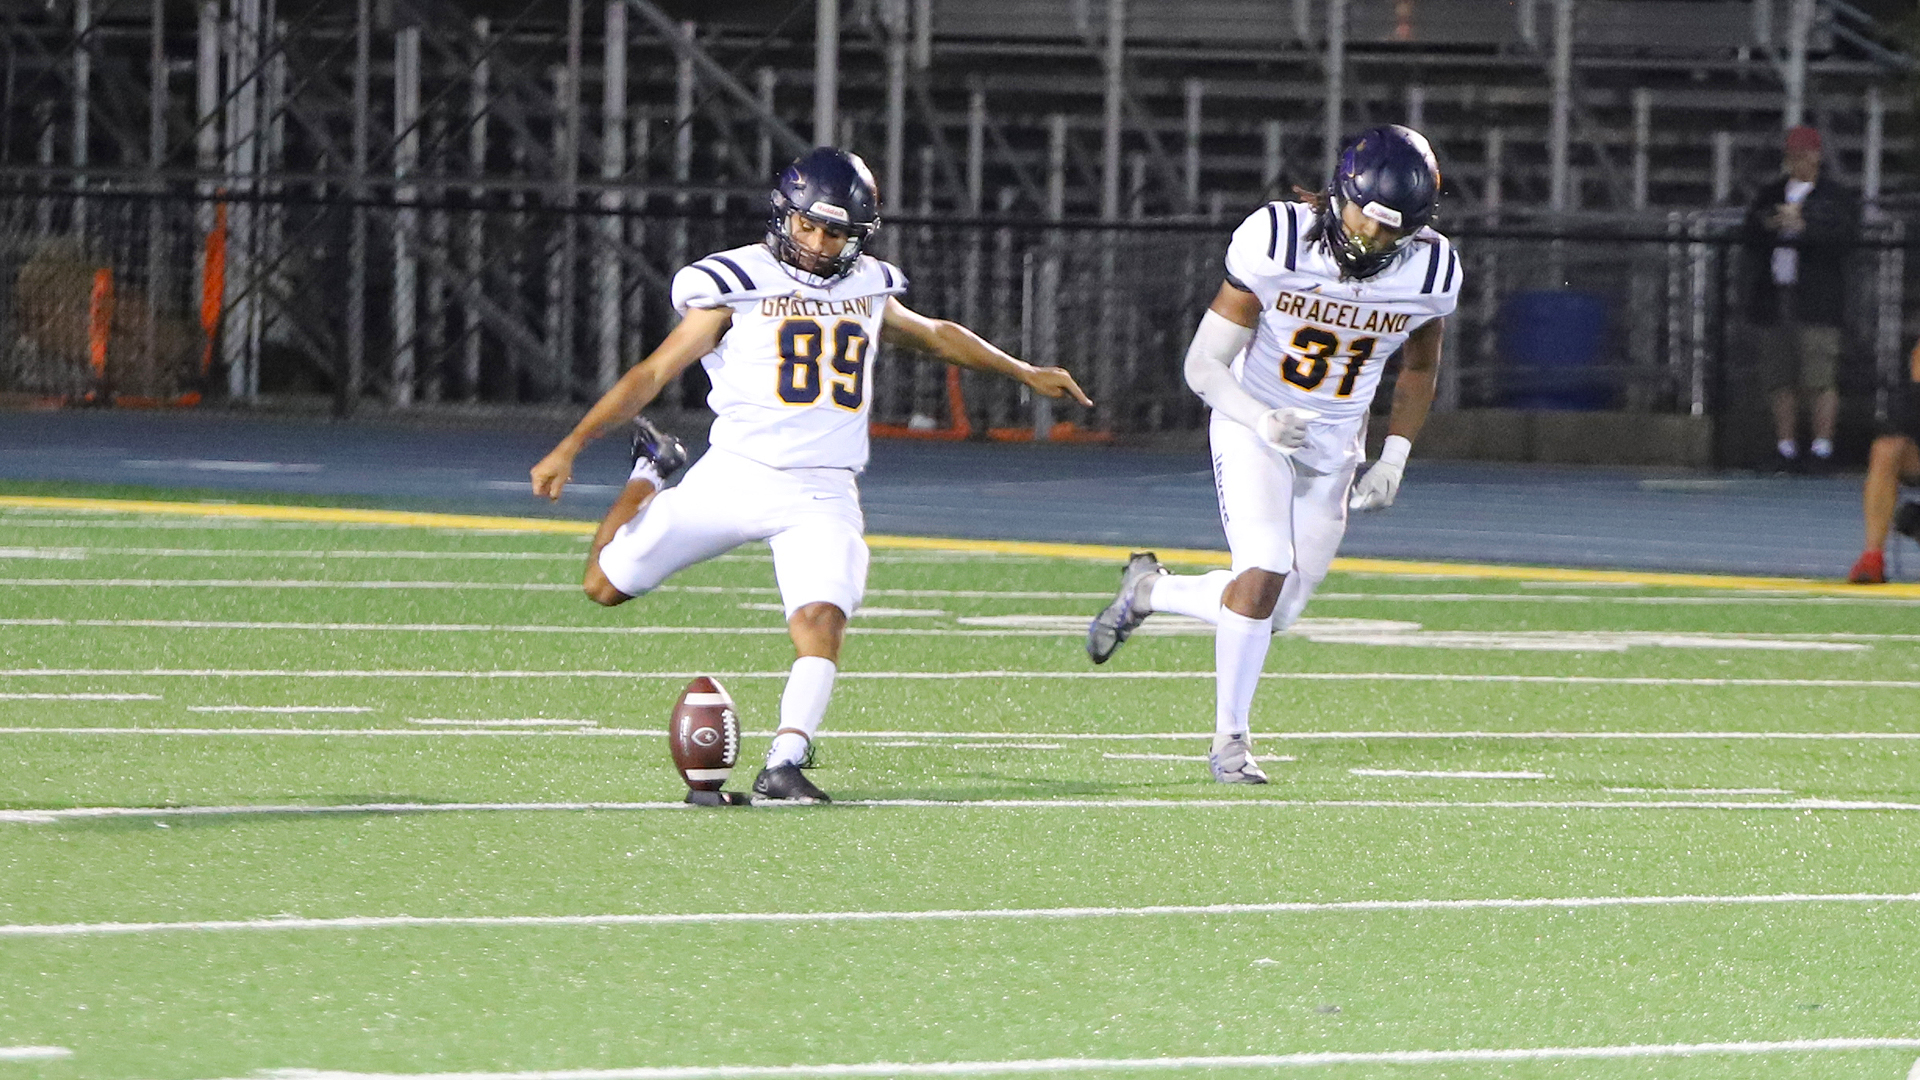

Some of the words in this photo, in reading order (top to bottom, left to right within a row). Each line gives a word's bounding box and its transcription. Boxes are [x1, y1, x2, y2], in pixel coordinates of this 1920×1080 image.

[816, 203, 845, 217] Riddell
[1275, 291, 1411, 333] GRACELAND
[775, 316, 869, 413] 89
[1280, 323, 1377, 399] 31
